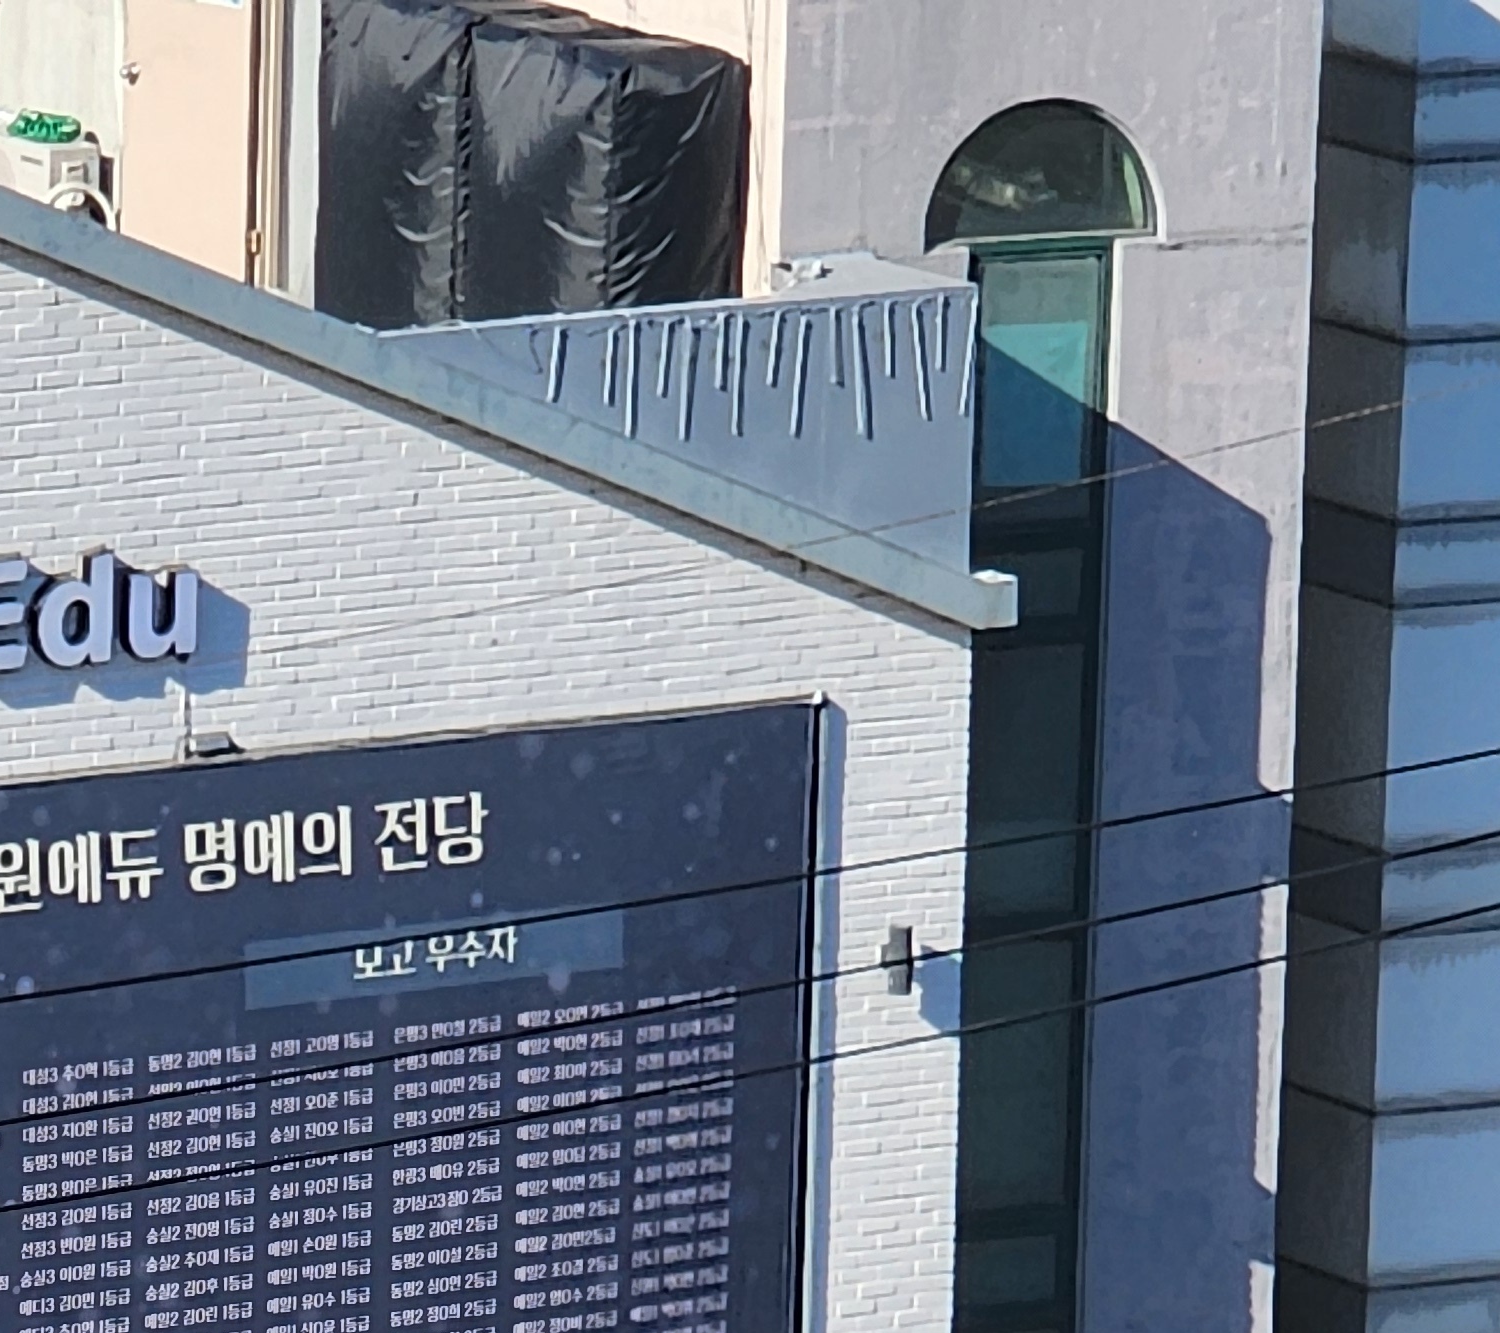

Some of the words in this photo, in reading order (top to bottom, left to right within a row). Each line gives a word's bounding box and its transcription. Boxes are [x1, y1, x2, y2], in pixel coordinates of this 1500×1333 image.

[181, 805, 353, 893] 명예의
[372, 791, 490, 873] 전당
[424, 925, 518, 974] 우수자
